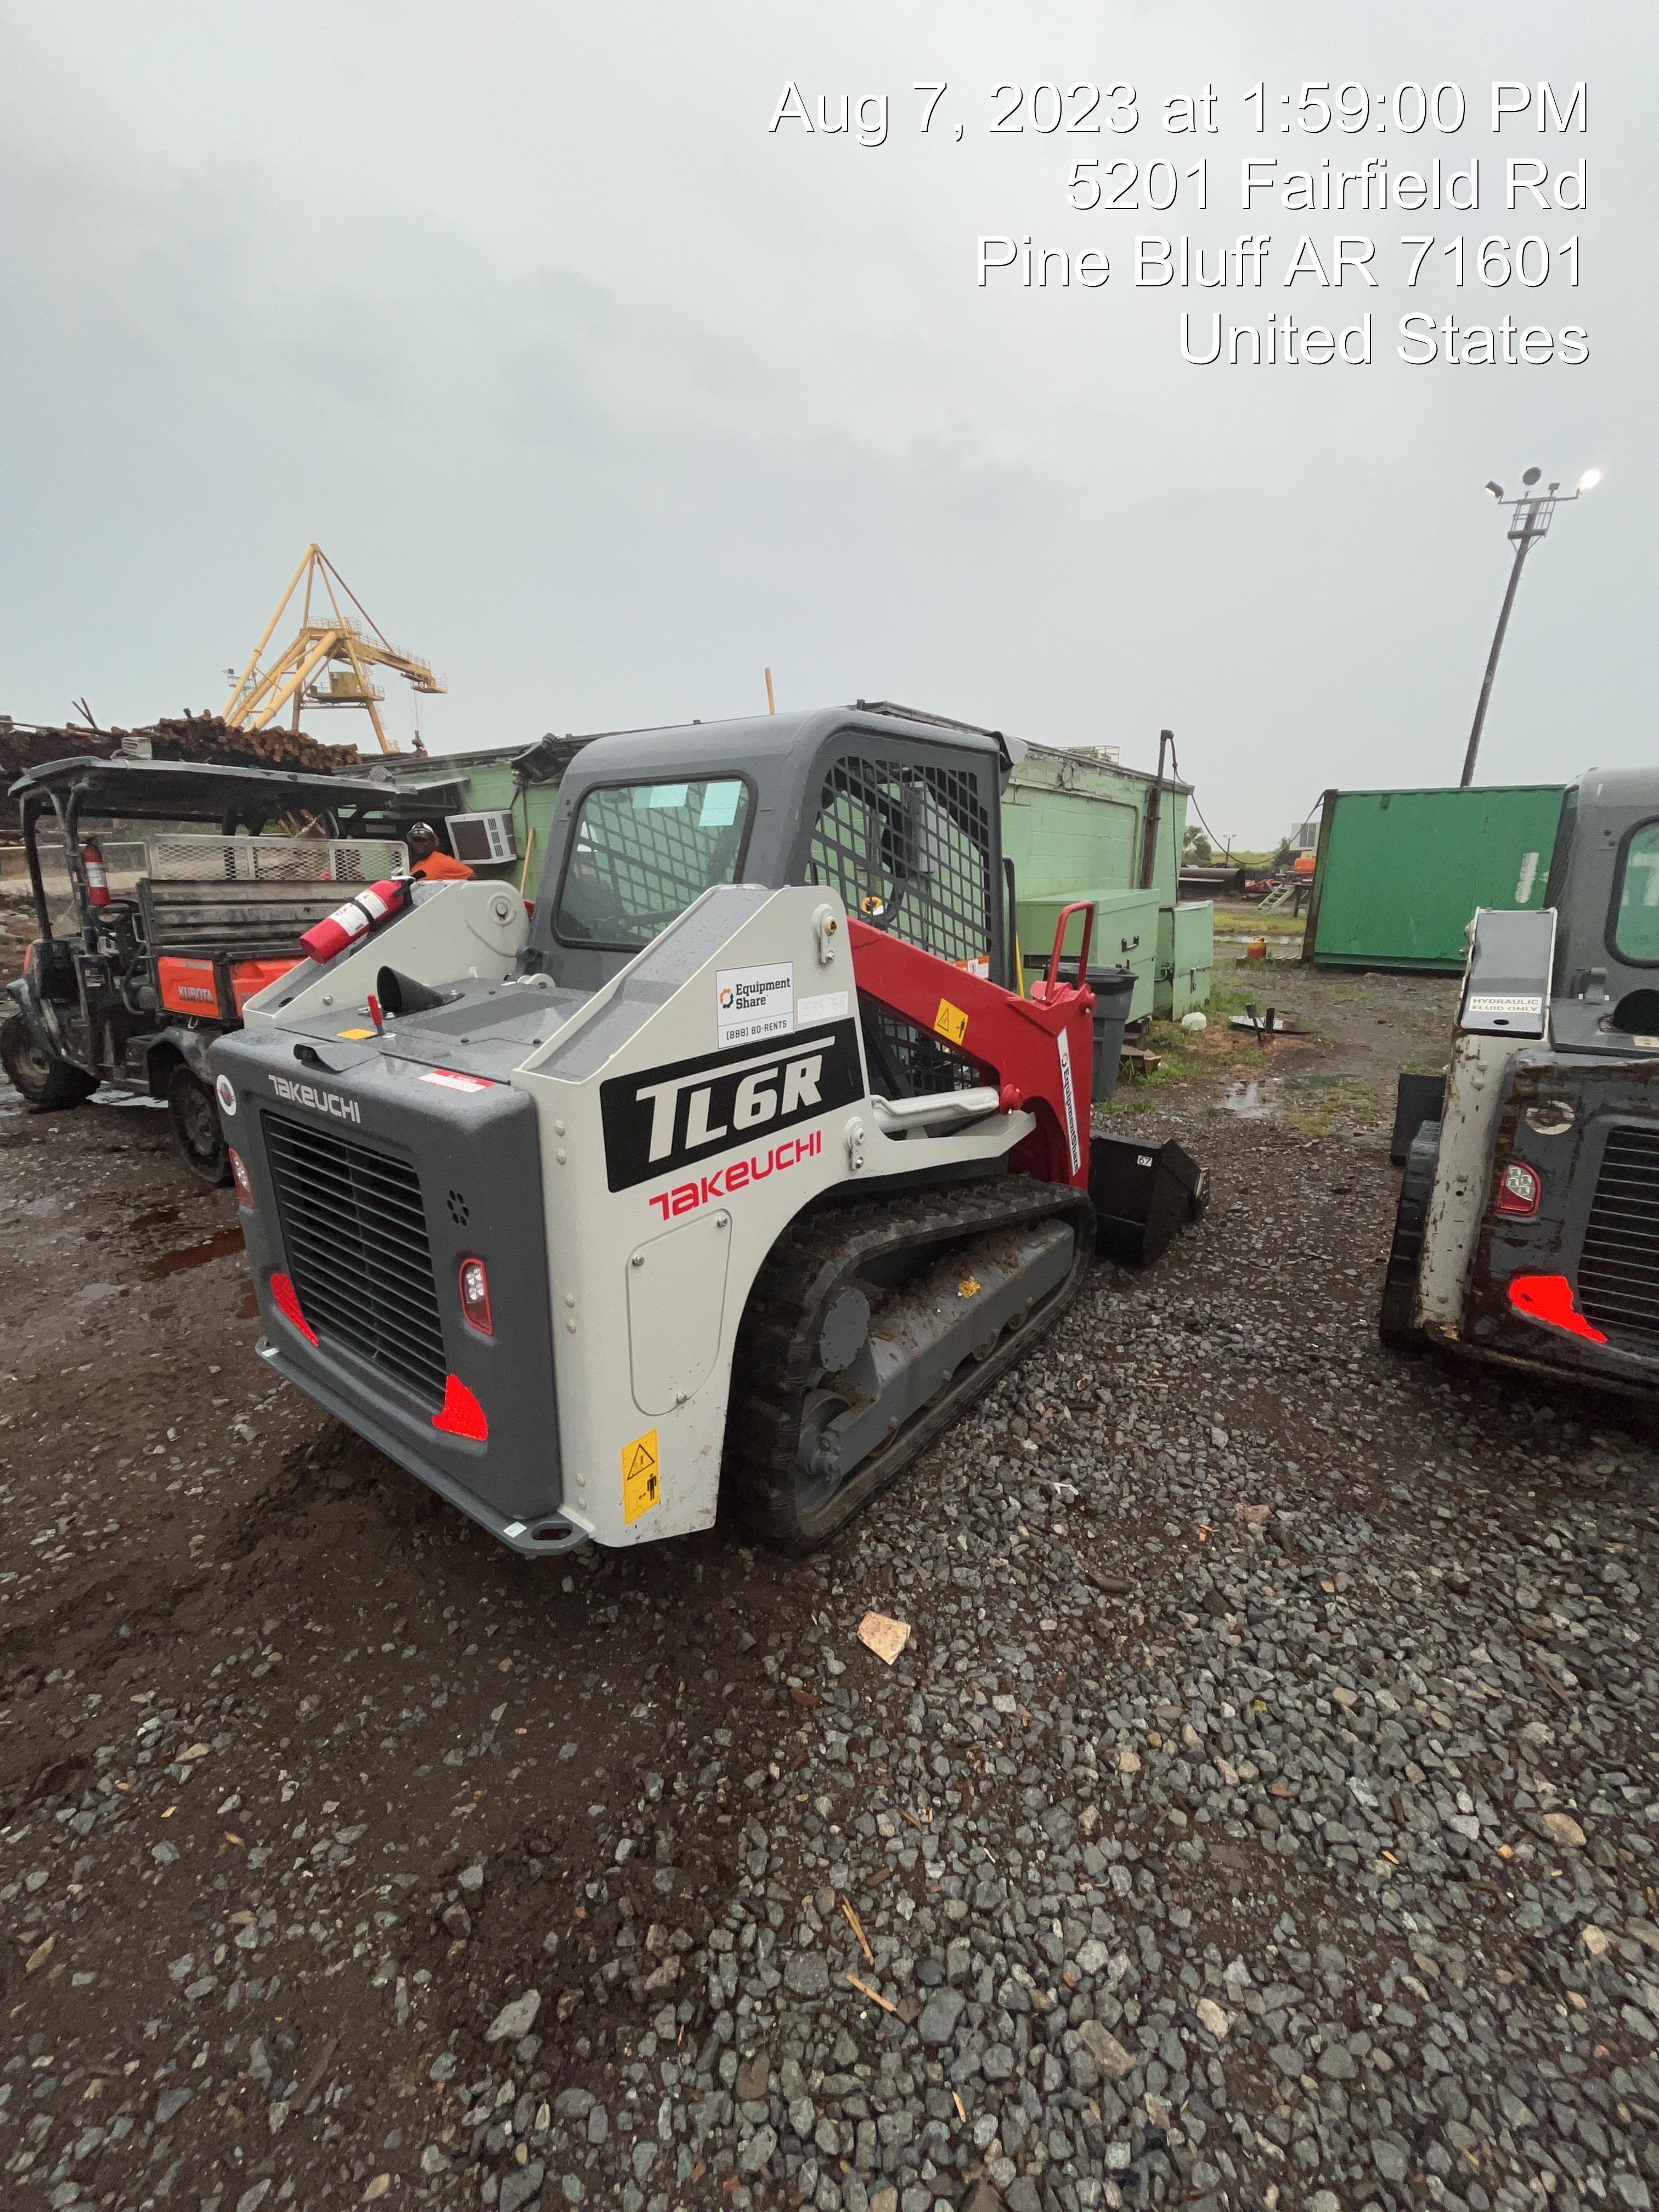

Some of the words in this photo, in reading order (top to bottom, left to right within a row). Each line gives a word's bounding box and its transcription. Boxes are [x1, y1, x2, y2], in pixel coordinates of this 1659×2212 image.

[178, 985, 213, 1003] KUBOTA
[736, 978, 791, 996] Equipment
[736, 996, 766, 1010] Share
[727, 1028, 748, 1040] (888)
[751, 1020, 787, 1035] 80-RENTS
[636, 1036, 836, 1163] TL6R
[1063, 1068, 1079, 1172] EquipmentShare
